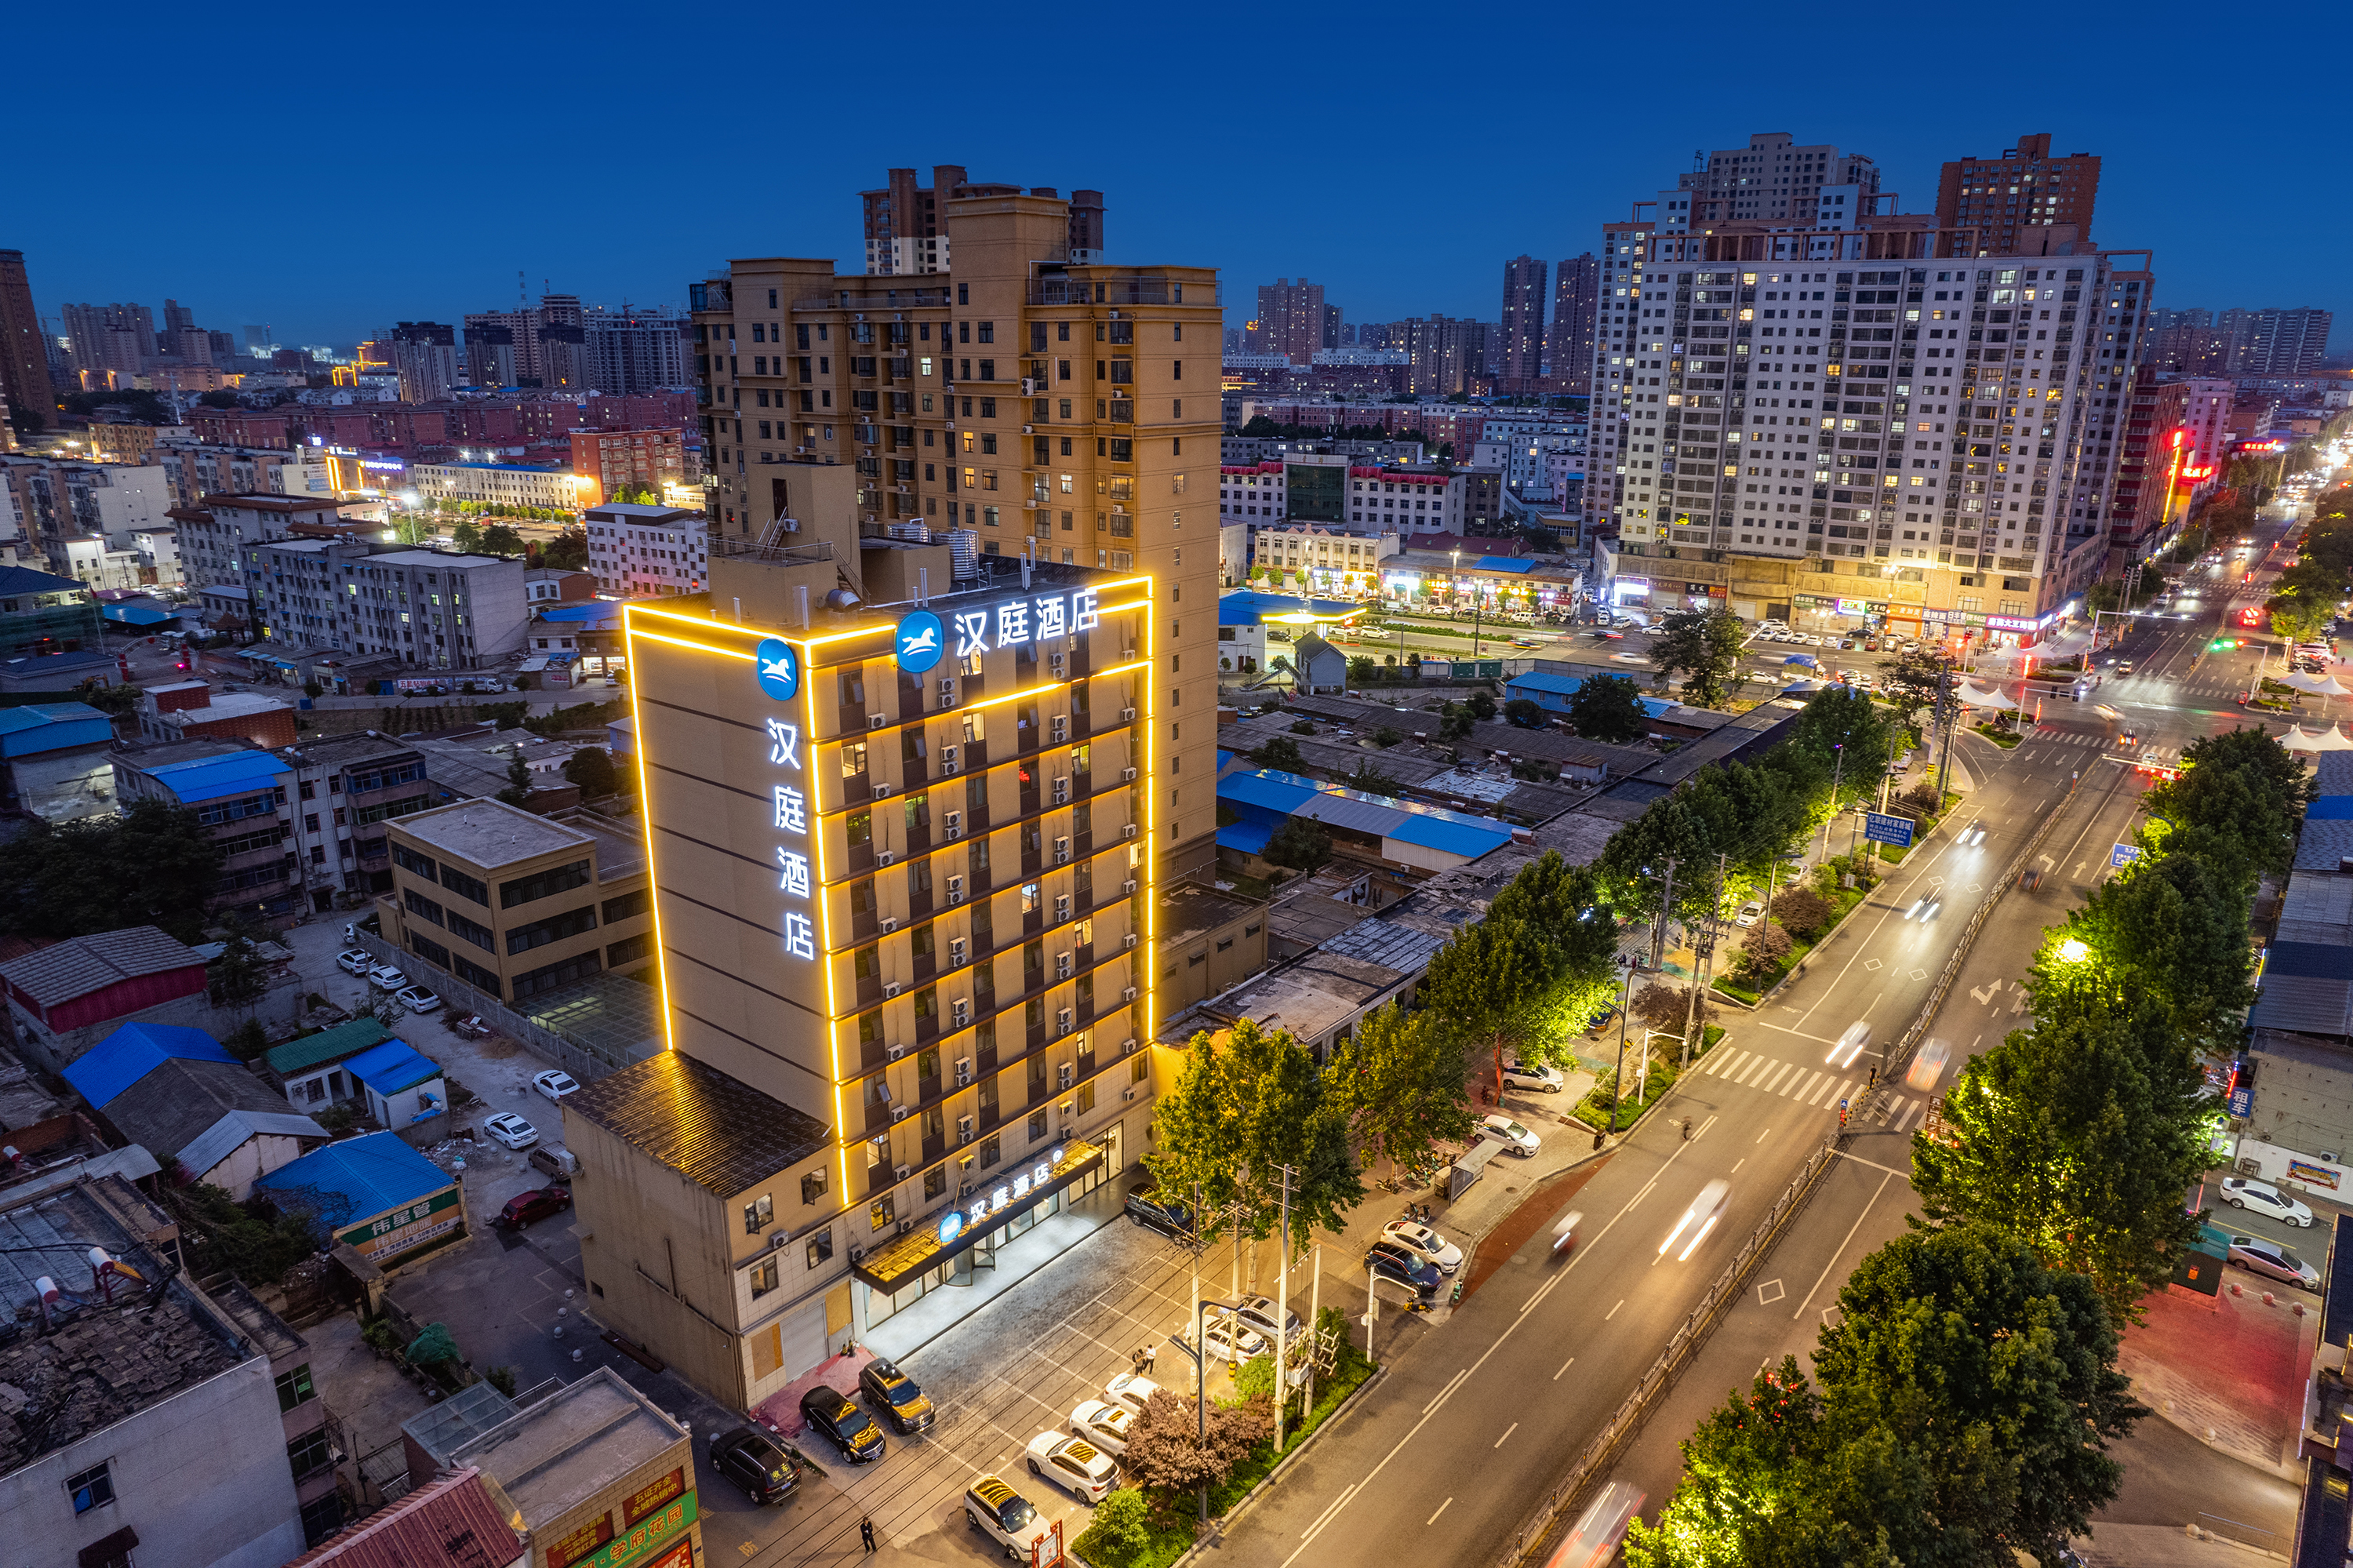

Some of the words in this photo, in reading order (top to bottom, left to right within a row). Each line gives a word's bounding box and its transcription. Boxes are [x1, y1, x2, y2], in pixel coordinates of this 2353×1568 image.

[955, 588, 1100, 657] 汉庭酒店
[1966, 613, 1987, 623] 便利店
[1869, 815, 1911, 831] 亿联建材家居城
[768, 718, 815, 961] 汉庭酒店
[2231, 1091, 2249, 1114] 租车
[970, 1162, 1049, 1224] 汉庭酒店
[371, 1201, 431, 1235] 伟星管
[375, 1217, 433, 1249] 伟星地暖
[631, 1483, 678, 1518] 全城热销中
[635, 1476, 672, 1504] 五证齐全
[564, 1527, 597, 1554] 二实验旁
[565, 1537, 598, 1562] 书香红盘
